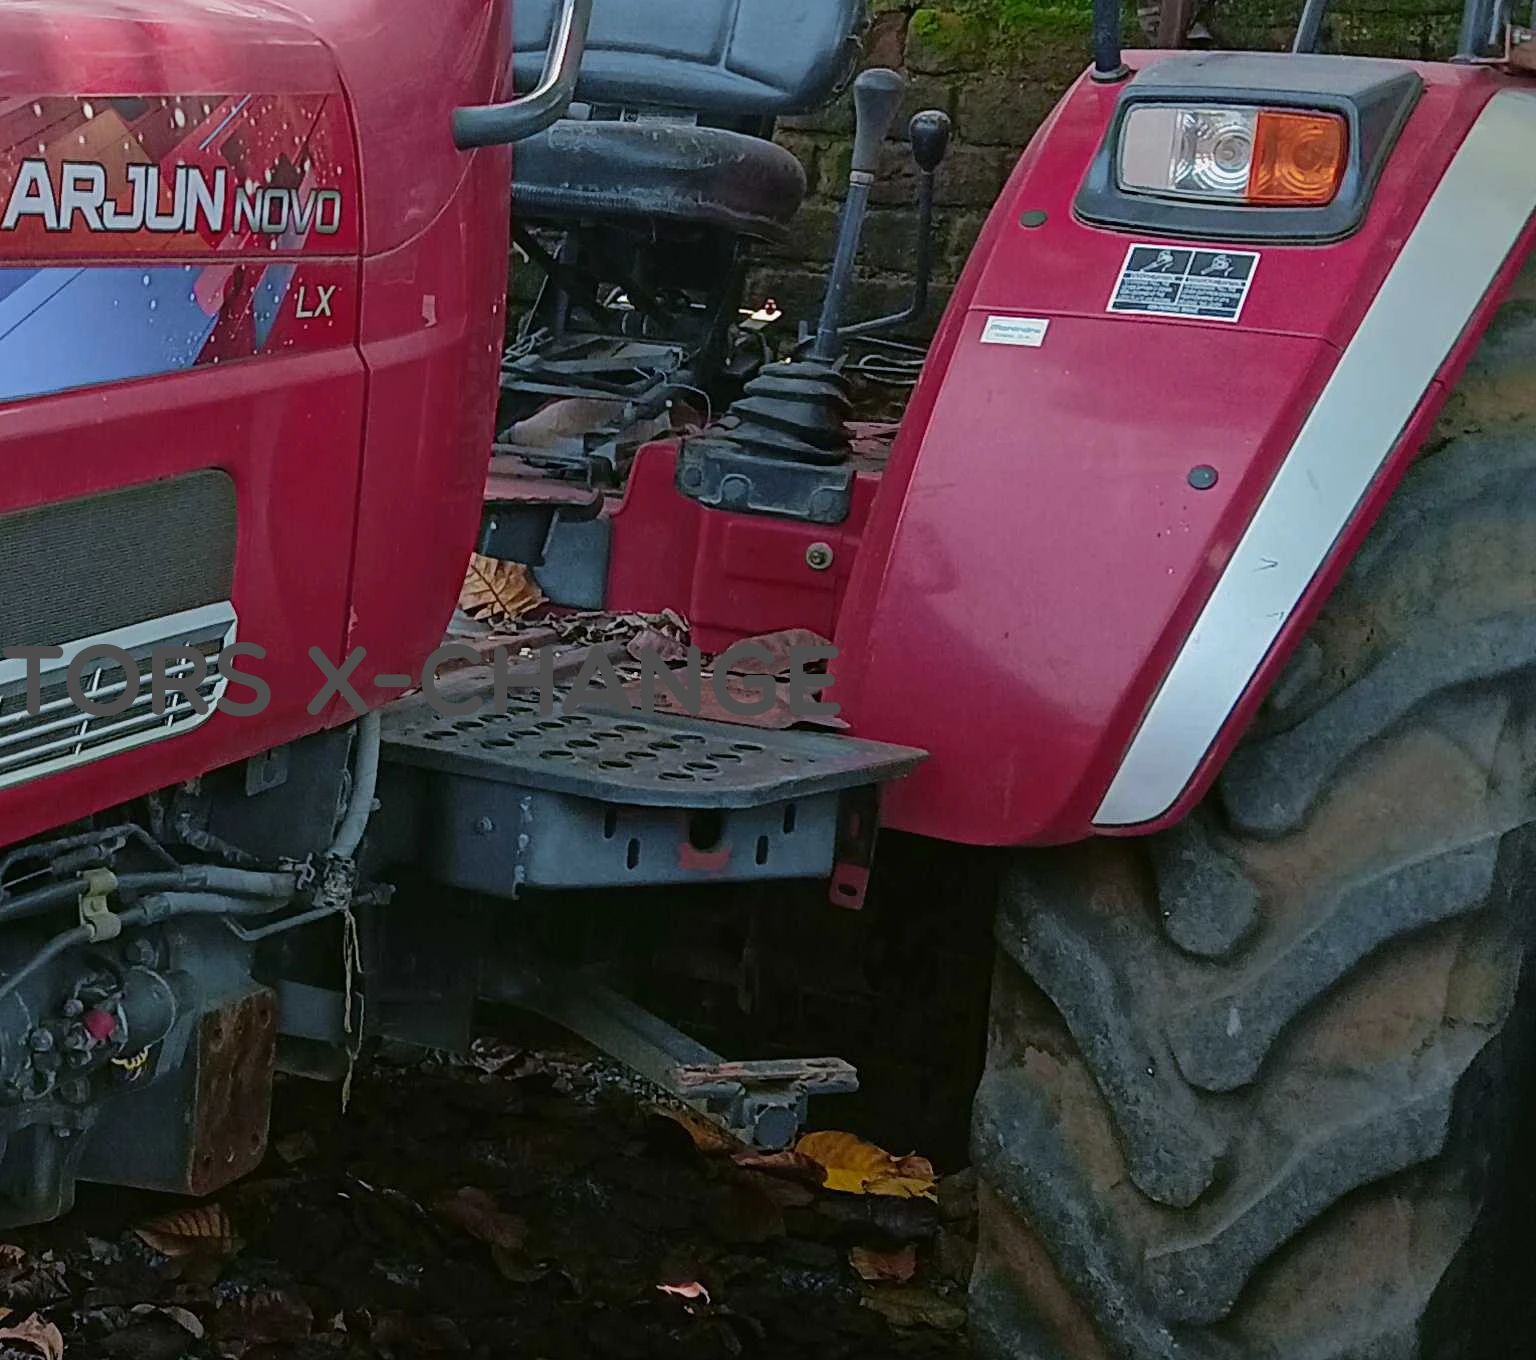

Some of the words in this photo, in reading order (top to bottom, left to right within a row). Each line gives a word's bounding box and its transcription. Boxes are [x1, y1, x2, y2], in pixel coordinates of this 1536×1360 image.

[0, 159, 227, 233] ARJUN
[232, 188, 342, 235] NOVO
[295, 285, 335, 319] LX
